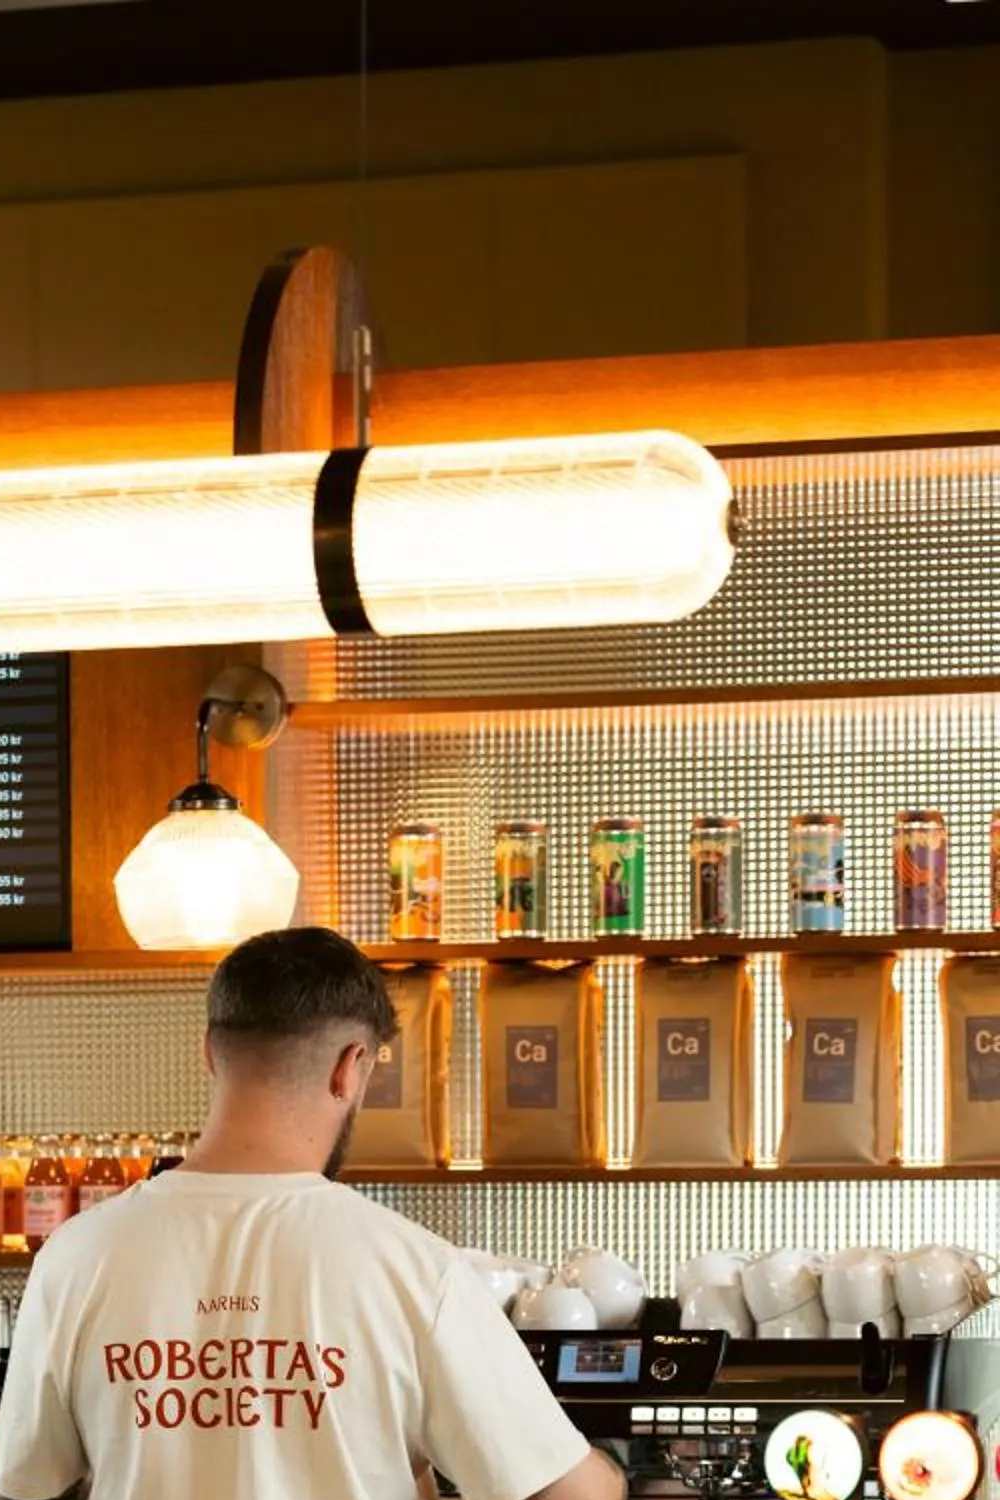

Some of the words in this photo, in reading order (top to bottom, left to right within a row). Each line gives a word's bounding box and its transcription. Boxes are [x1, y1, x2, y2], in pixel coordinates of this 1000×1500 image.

[9, 667, 22, 679] kr
[9, 734, 23, 747] kr
[10, 752, 24, 766] kr
[11, 770, 24, 783] kr
[11, 789, 24, 802] kr
[11, 808, 25, 821] kr
[12, 826, 25, 839] kr
[13, 875, 26, 888] kr
[13, 893, 26, 906] kr
[667, 1032, 699, 1055] Ca
[813, 1032, 846, 1056] Ca
[515, 1040, 547, 1062] Ca
[197, 1295, 260, 1315] AARHUS
[104, 1338, 346, 1389] ROBERTA'S
[135, 1385, 327, 1430] SOCIETY
